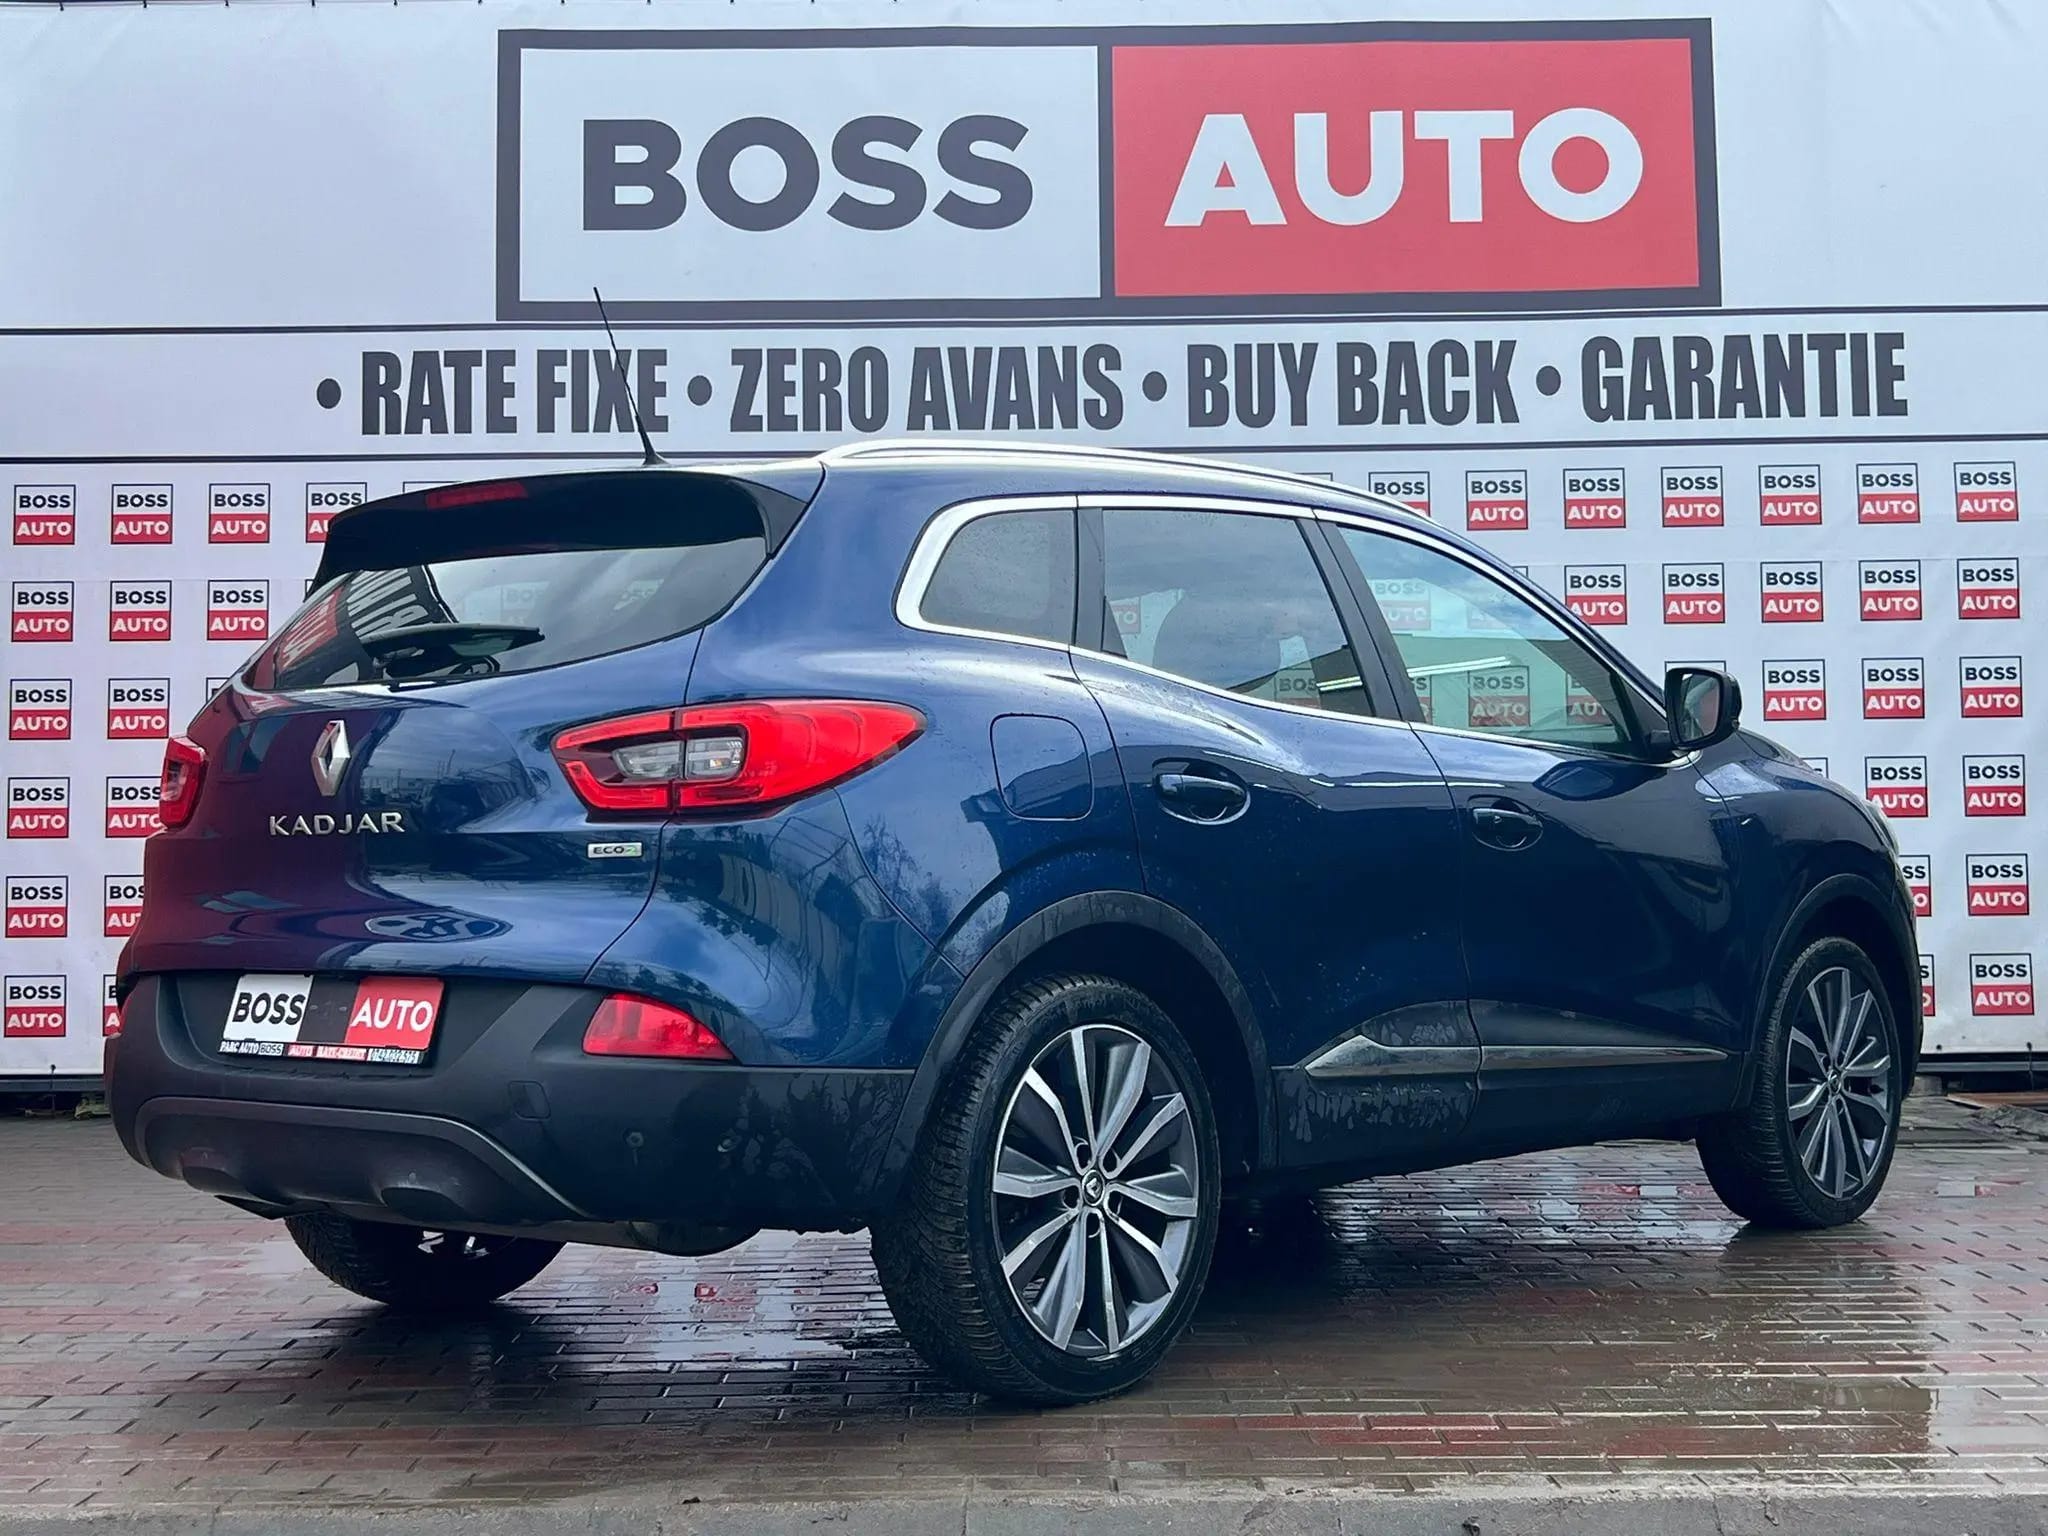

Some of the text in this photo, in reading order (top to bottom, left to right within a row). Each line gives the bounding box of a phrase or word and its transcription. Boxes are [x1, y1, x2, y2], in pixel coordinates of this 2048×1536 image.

[583, 107, 1643, 232] BOSS AUTO
[361, 332, 1909, 435] RATE FIXE ZERO AVANS BUY BACK GARANTIE
[1569, 478, 1620, 492] BOSS
[1667, 477, 1718, 490] BOSS
[1764, 475, 1816, 488] BOSS
[1862, 474, 1913, 487] BOSS
[1960, 472, 2011, 485] BOSS
[1375, 482, 1425, 495] BOSS
[1472, 480, 1522, 494] BOSS
[20, 495, 70, 508] BOSS
[117, 494, 167, 507] BOSS
[215, 494, 265, 506] BOSS
[311, 492, 362, 506] BOSS
[1960, 498, 2014, 512] AUTO
[1470, 507, 1524, 521] AUTO
[1568, 505, 1622, 519] AUTO
[1665, 504, 1720, 518] AUTO
[1764, 502, 1818, 516] AUTO
[1862, 500, 1916, 514] AUTO
[17, 522, 71, 535] AUTO
[114, 521, 169, 534] AUTO
[212, 521, 266, 534] AUTO
[1571, 575, 1621, 588] BOSS
[1668, 573, 1719, 586] BOSS
[1766, 572, 1817, 585] BOSS
[1865, 570, 1916, 583] BOSS
[1963, 568, 2014, 582] BOSS
[18, 592, 68, 604] BOSS
[116, 591, 166, 604] BOSS
[213, 590, 263, 603] BOSS
[1962, 595, 2016, 609] AUTO
[1570, 602, 1624, 616] AUTO
[1667, 600, 1721, 614] AUTO
[1765, 599, 1819, 613] AUTO
[1864, 597, 1918, 611] AUTO
[112, 618, 167, 631] AUTO
[210, 617, 265, 631] AUTO
[1116, 610, 1137, 625] TO
[15, 619, 69, 632] AUTO
[1768, 670, 1820, 683] BOSS
[1868, 668, 1919, 681] BOSS
[1966, 667, 2017, 680] BOSS
[1279, 678, 1317, 692] BOS
[1473, 676, 1525, 690] BOSS
[16, 689, 66, 702] BOSS
[114, 689, 164, 702] BOSS
[1867, 695, 1921, 709] AUTO
[1965, 694, 2019, 708] AUTO
[1472, 702, 1527, 717] AUTO
[1570, 703, 1607, 717] AUT
[1767, 697, 1822, 711] AUTO
[13, 717, 67, 730] AUTO
[111, 716, 165, 729] AUTO
[1871, 767, 1922, 780] BOSS
[1969, 765, 2020, 779] BOSS
[14, 788, 64, 801] BOSS
[112, 787, 161, 800] BOSS
[1968, 793, 2022, 807] AUTO
[1870, 794, 1924, 808] AUTO
[10, 815, 65, 829] AUTO
[269, 811, 406, 836] KADJAR
[1902, 866, 1925, 878] SS
[1972, 864, 2023, 878] BOSS
[12, 886, 62, 900] BOSS
[110, 886, 144, 899] BOS
[1971, 892, 2025, 906] AUTO
[9, 914, 64, 928] AUTO
[1976, 964, 2027, 977] BOSS
[10, 986, 61, 999] BOSS
[1976, 992, 2030, 1006] AUTO
[232, 992, 434, 1032] BOSS AUTO
[7, 1014, 62, 1027] AUTO
[238, 1043, 259, 1054] AUTO
[259, 1044, 282, 1055] BOSS
